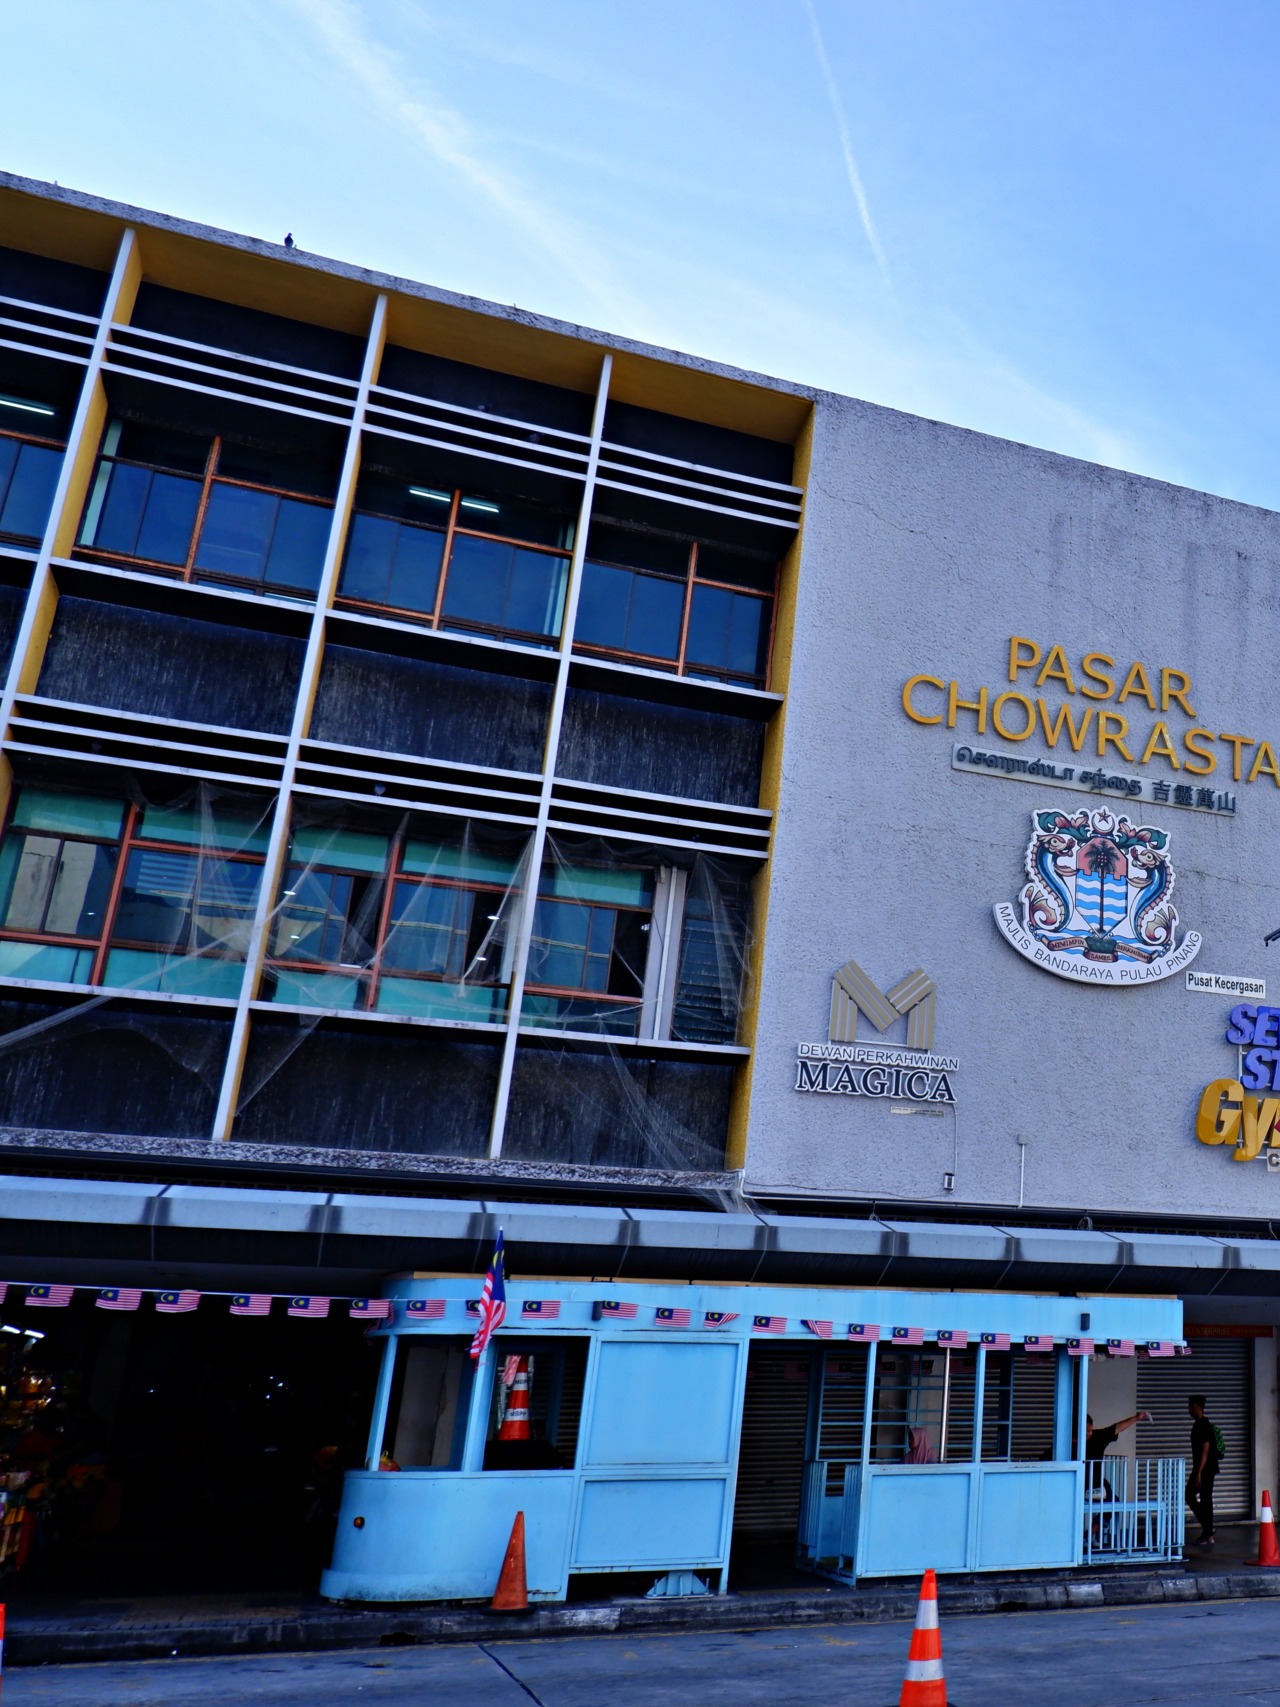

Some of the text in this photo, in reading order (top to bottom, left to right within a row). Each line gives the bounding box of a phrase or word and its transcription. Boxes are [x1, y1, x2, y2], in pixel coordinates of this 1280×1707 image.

[1008, 635, 1197, 718] PASAR
[998, 905, 1201, 981] MAJLIS BANDARAYA PULAU PINANG
[1187, 973, 1264, 995] Pusat Kecergasan
[800, 1043, 959, 1070] DEWAN PERKAHWINAN
[796, 1059, 958, 1103] MAGICA
